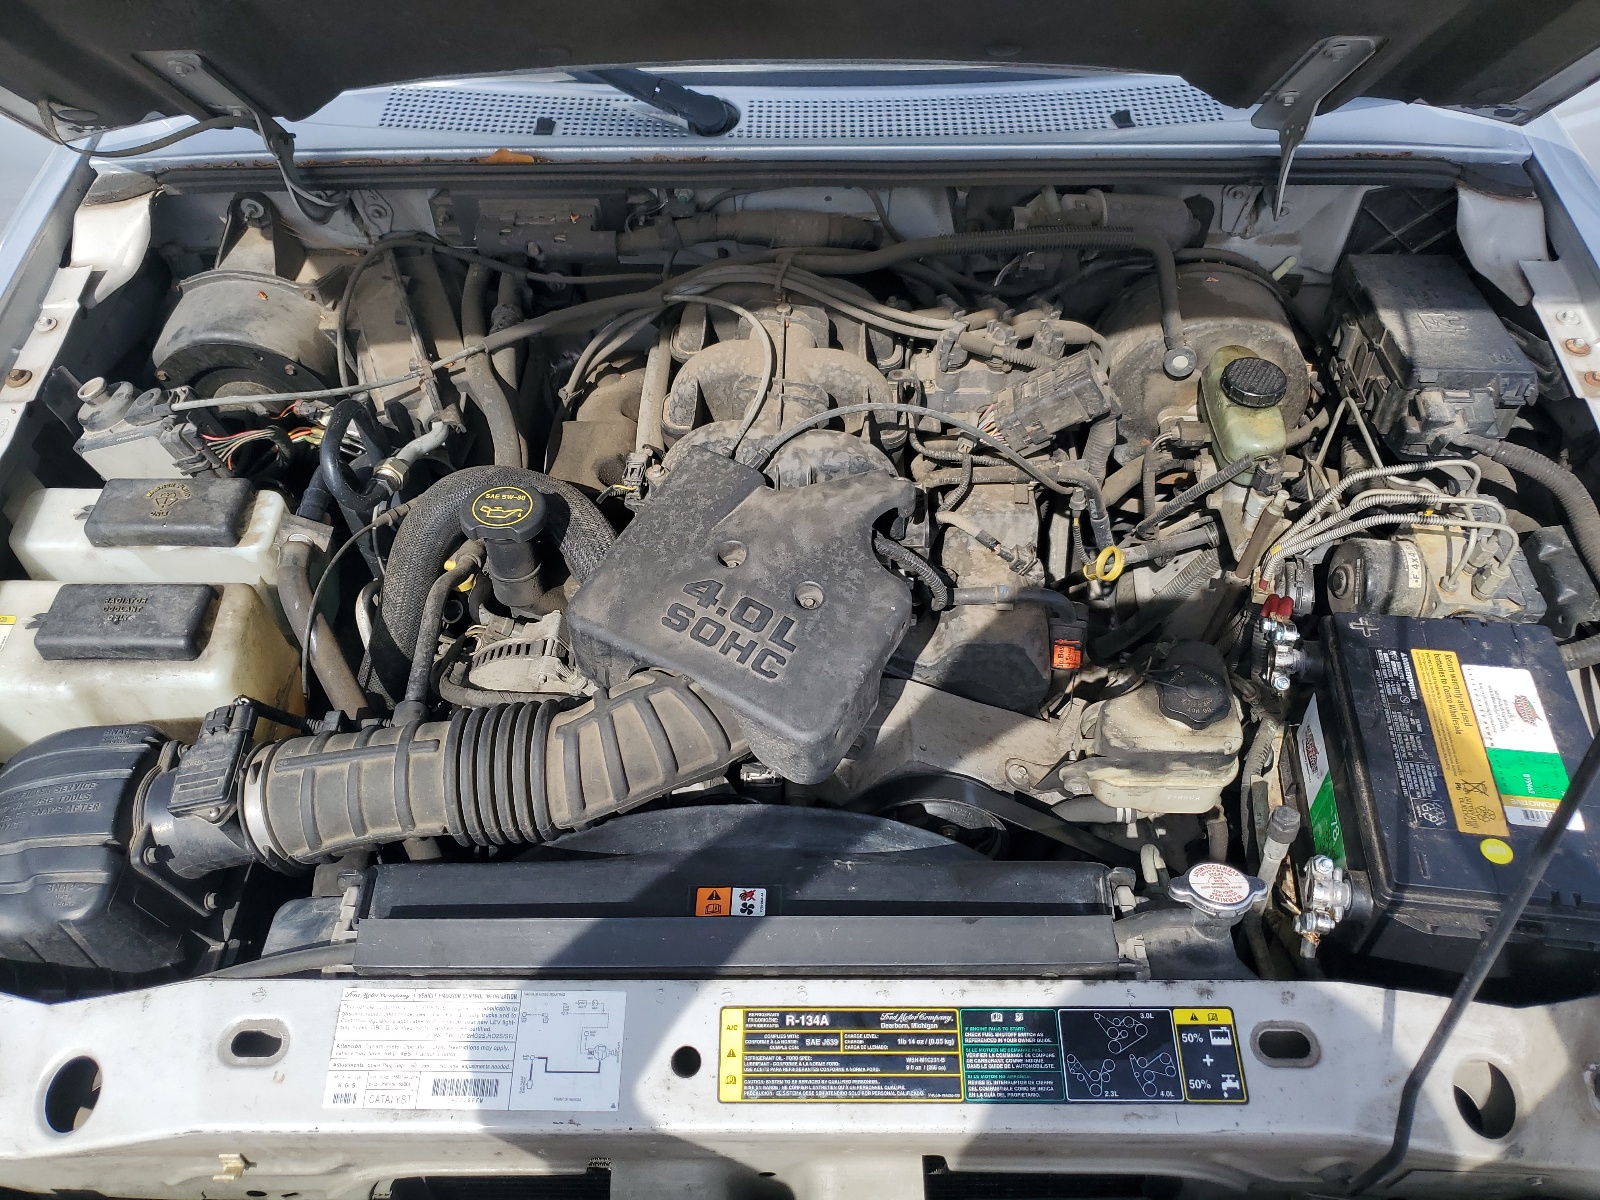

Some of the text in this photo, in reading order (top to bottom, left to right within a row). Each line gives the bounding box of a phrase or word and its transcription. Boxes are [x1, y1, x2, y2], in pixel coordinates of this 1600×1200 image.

[682, 580, 797, 653] 4.0L
[662, 602, 786, 679] SOHC
[1434, 654, 1446, 680] batteries
[1443, 684, 1453, 704] Costco
[1448, 702, 1463, 735] Wholesale
[59, 792, 92, 802] TOOLS
[66, 803, 100, 813] AFTER
[1209, 894, 1244, 903] WARNING
[786, 1015, 829, 1026] R-134A
[880, 1013, 897, 1021] Ford
[896, 1012, 919, 1022] Motor
[1182, 1033, 1203, 1042] 50%
[1189, 1079, 1211, 1089] 50%
[368, 1094, 412, 1104] CATALYST
